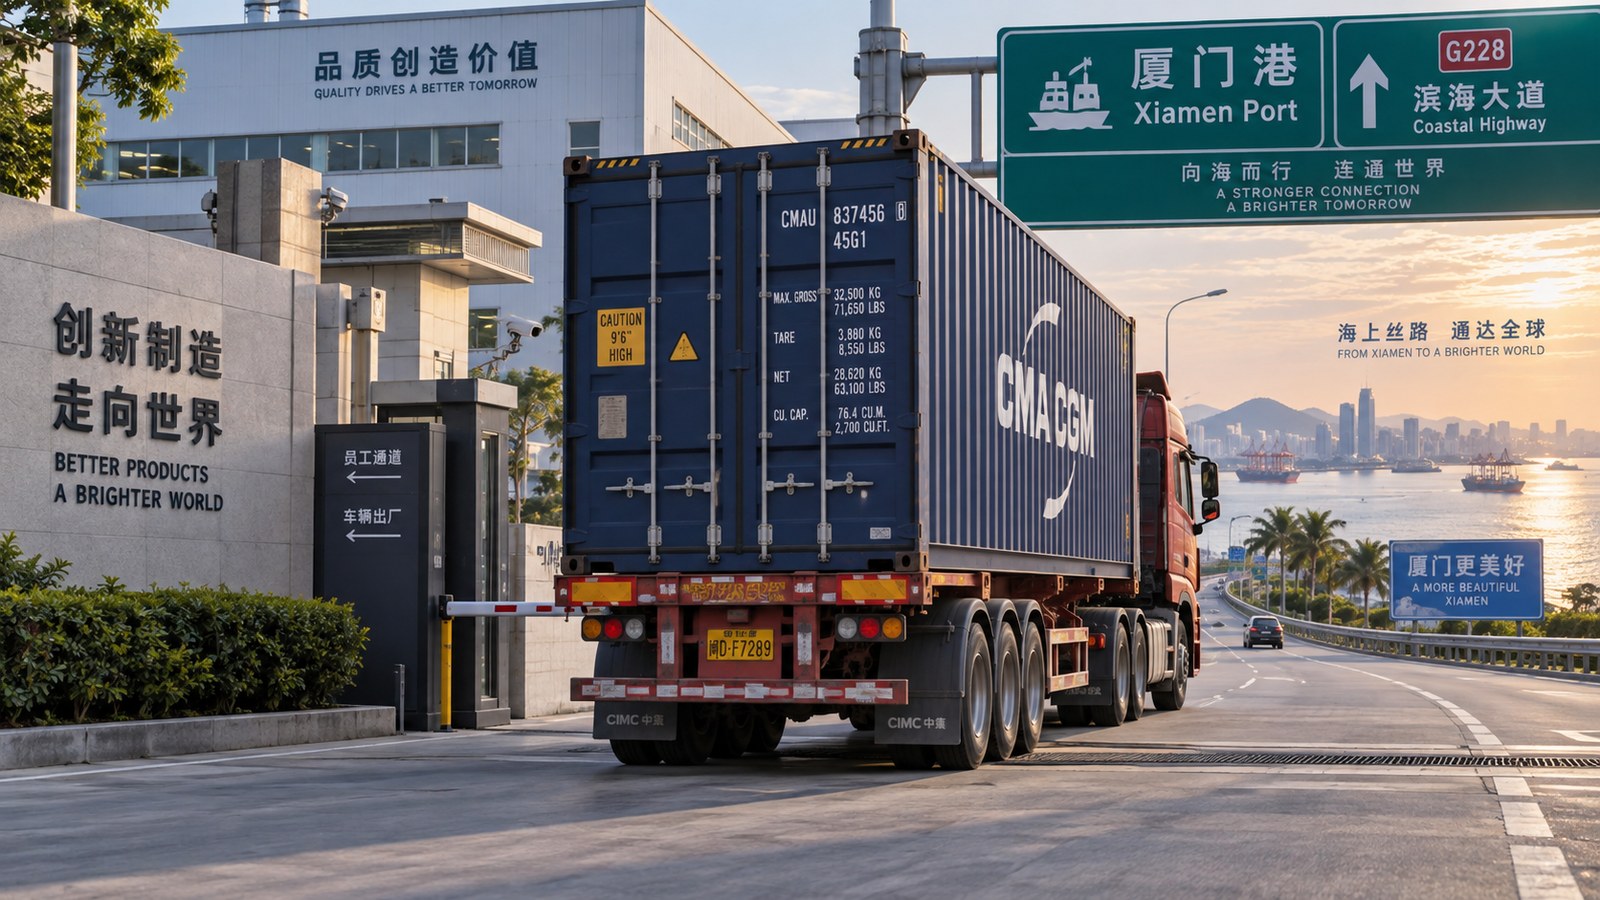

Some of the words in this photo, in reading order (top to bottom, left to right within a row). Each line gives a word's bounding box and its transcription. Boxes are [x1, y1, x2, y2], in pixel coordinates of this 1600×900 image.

[1445, 38, 1505, 63] G228
[314, 39, 539, 82] 品质创造价值
[1131, 42, 1298, 90] 厦门港
[314, 87, 362, 100] QUALITY
[366, 84, 405, 96] DRIVES
[409, 84, 418, 94] A
[421, 82, 465, 93] BETTER
[469, 78, 538, 91] TOMORROW
[1413, 80, 1546, 113] 滨海大道
[1134, 101, 1233, 125] Xiamen
[1243, 99, 1298, 122] Port
[1413, 117, 1474, 134] Coastal
[1480, 116, 1547, 135] Highway
[1181, 161, 1292, 183] 向海而行
[1334, 158, 1445, 180] 连通世界
[1216, 188, 1226, 199] A
[1232, 186, 1314, 199] STRONGER
[1320, 184, 1420, 198] CONNECTION
[1226, 202, 1236, 213] A
[1243, 200, 1318, 212] BRIGHTER
[1323, 198, 1412, 211] TOMORROW
[781, 208, 816, 228] CMAU
[833, 203, 885, 225] 837456
[833, 230, 866, 250] 45G1
[773, 291, 793, 304] MAX.
[794, 290, 818, 303] GROSS
[868, 286, 881, 299] KG
[834, 301, 865, 316] 71,650
[868, 301, 886, 314] LBS
[600, 312, 642, 328] CAUTION
[53, 301, 223, 380] 创新制造
[773, 331, 796, 344] TARE
[868, 326, 881, 340] KG
[609, 348, 633, 362] HIGH
[838, 342, 865, 356] 8,550
[868, 341, 886, 354] LBS
[773, 370, 791, 383] NET
[868, 366, 882, 379] KG
[868, 381, 886, 394] LBS
[53, 378, 223, 447] 走向世界
[773, 409, 788, 421] CU.
[789, 408, 809, 421] CAP.
[838, 406, 858, 419] 76.4
[861, 406, 886, 419] CU.M.
[997, 352, 1051, 443] CMA
[1055, 381, 1095, 458] CGM
[834, 421, 860, 435] 2,700
[863, 420, 890, 433] CU.FT.
[344, 448, 402, 466] 员工通道
[55, 451, 120, 477] BETTER
[126, 458, 209, 484] PRODUCTS
[54, 482, 67, 503] A
[76, 484, 162, 509] BRIGHTER
[169, 490, 223, 512] WORLD
[1407, 553, 1525, 577] 厦门更美好
[1412, 582, 1420, 593] A
[1423, 582, 1455, 593] MORE
[1459, 582, 1520, 593] BEAUTIFUL
[1445, 596, 1489, 606] XIAMEN
[606, 713, 640, 726] CIMC
[887, 716, 922, 729] CIMC
